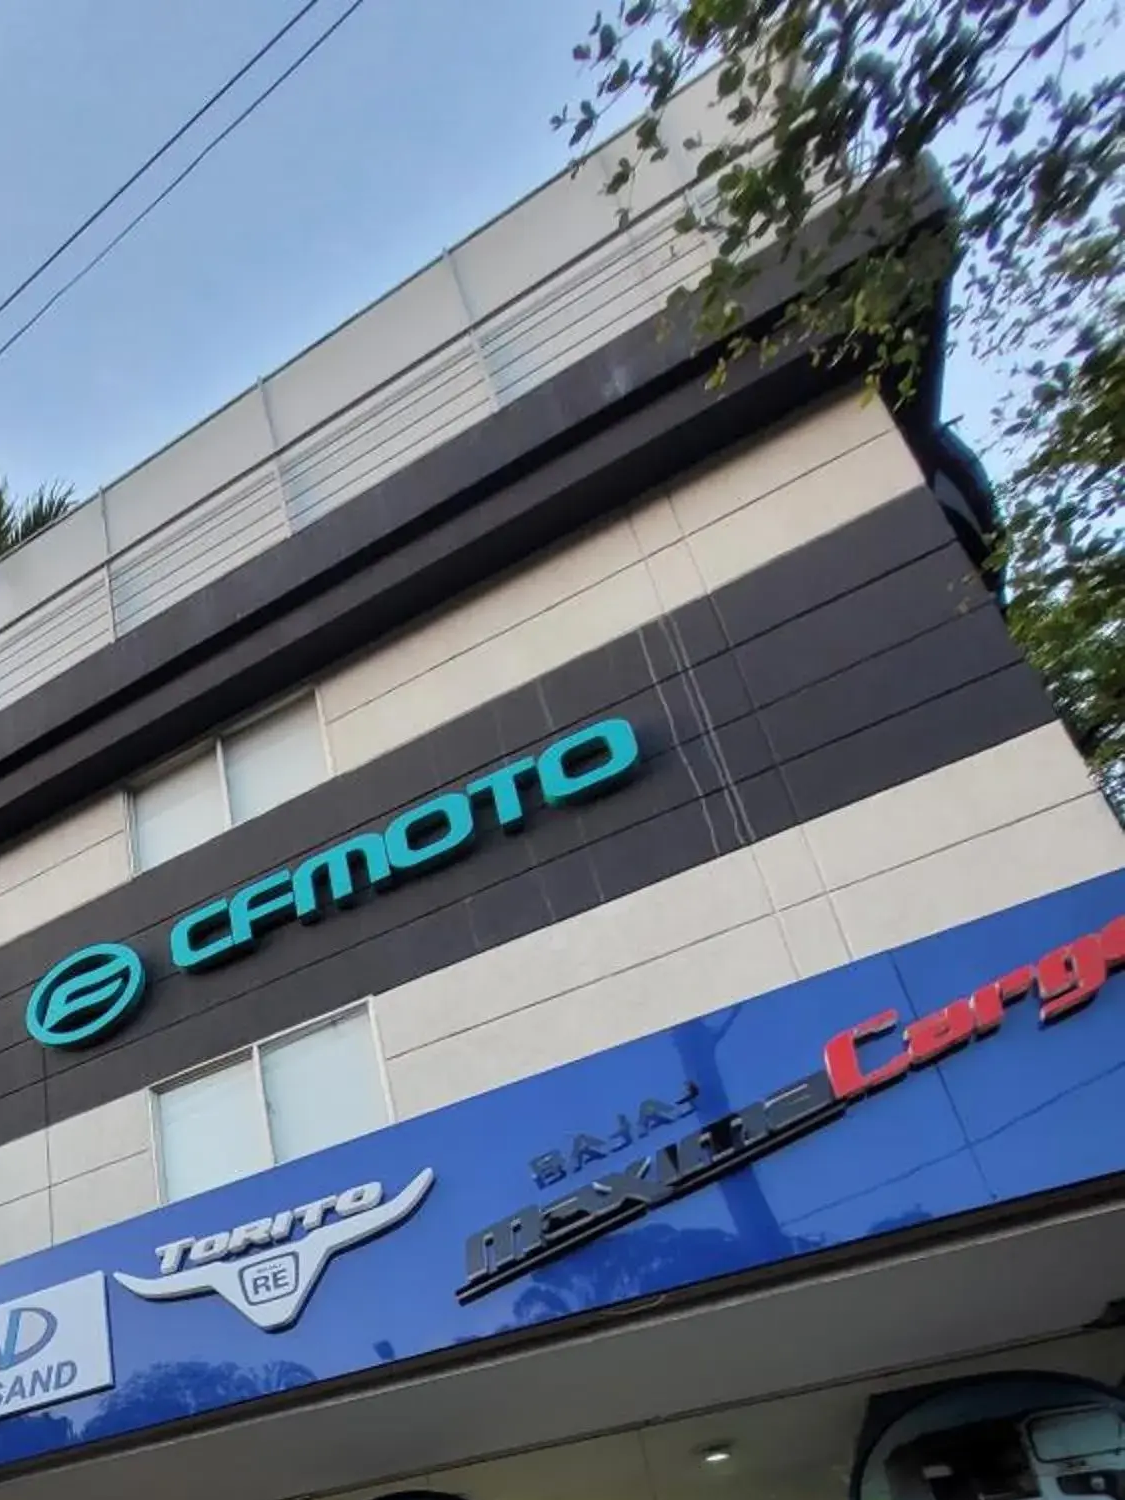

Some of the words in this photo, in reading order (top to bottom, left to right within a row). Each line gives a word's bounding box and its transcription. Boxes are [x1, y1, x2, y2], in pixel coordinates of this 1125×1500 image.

[169, 717, 641, 972] CFMOTO
[155, 1181, 383, 1274] TORITO
[252, 1268, 290, 1295] RE
